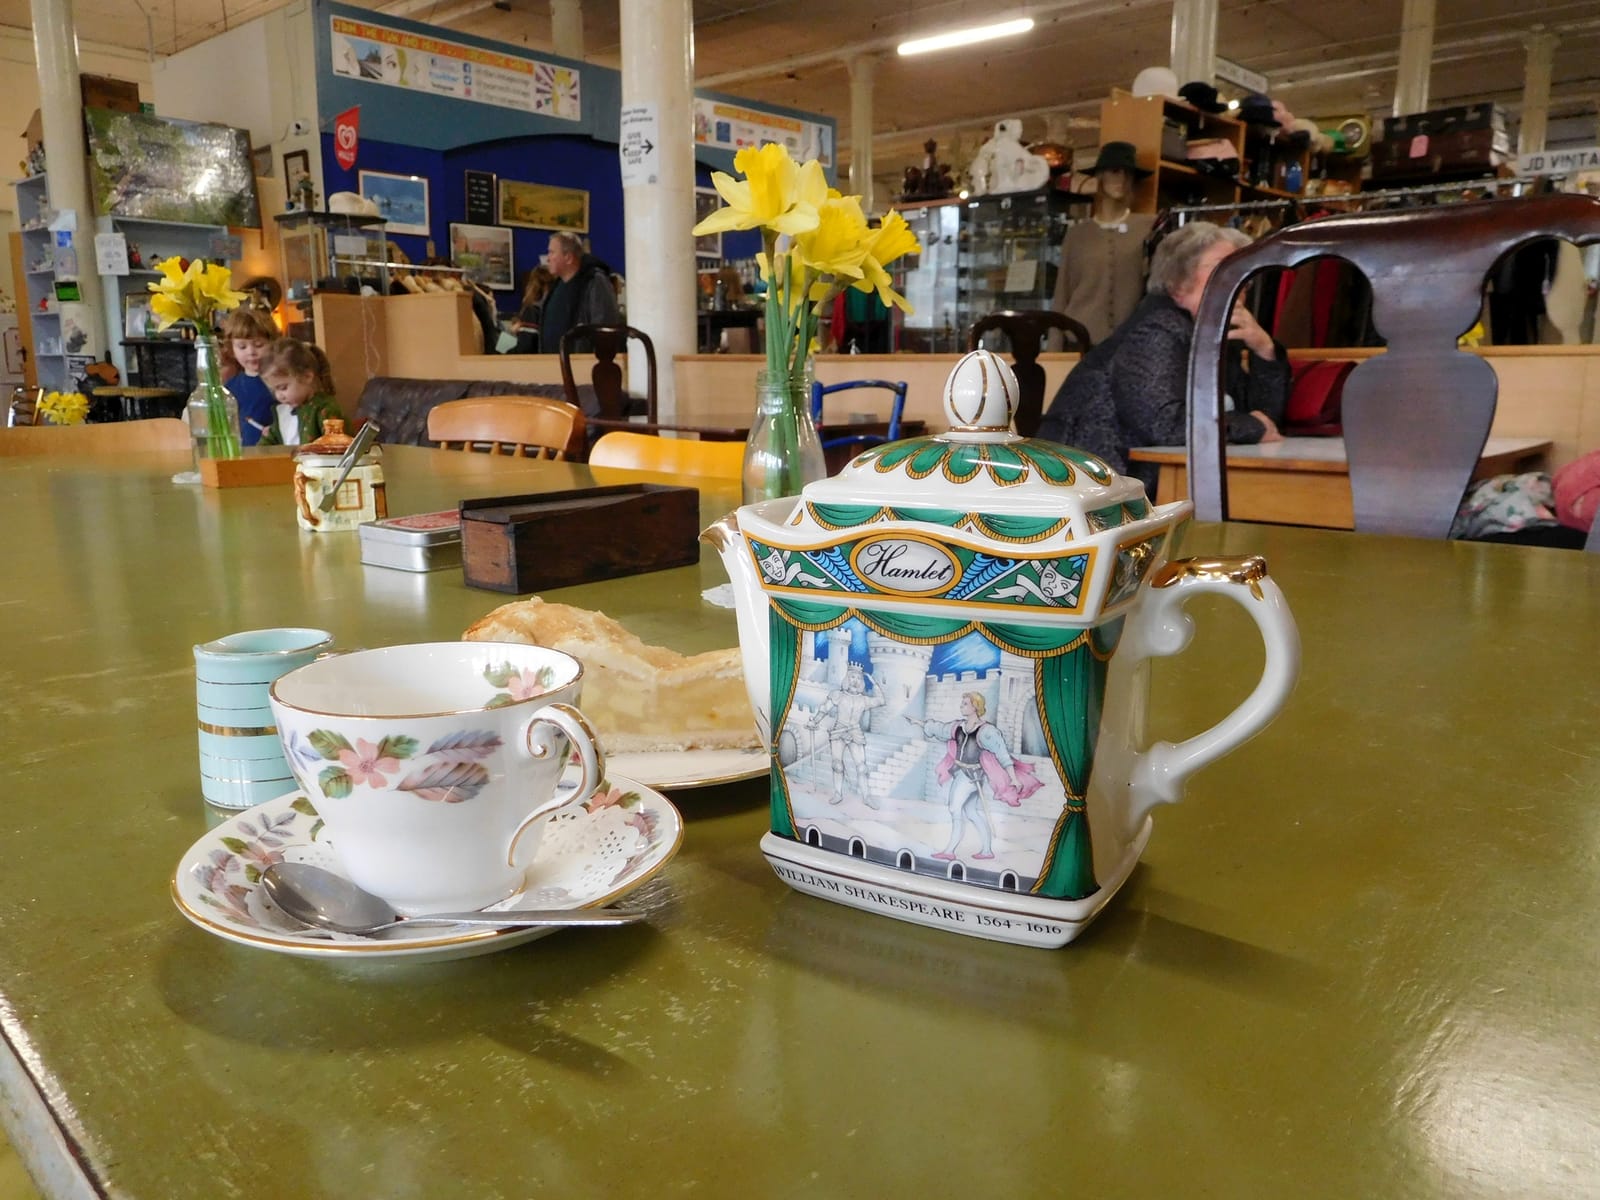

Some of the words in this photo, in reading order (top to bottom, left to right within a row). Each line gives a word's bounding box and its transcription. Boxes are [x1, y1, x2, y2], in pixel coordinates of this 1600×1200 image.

[1522, 156, 1544, 171] JD
[863, 544, 952, 581] Hamlet
[774, 864, 840, 892] WILLIAM
[844, 884, 966, 922] SHAKESPEARE
[976, 915, 1012, 929] 1564
[1026, 922, 1062, 935] 1616
